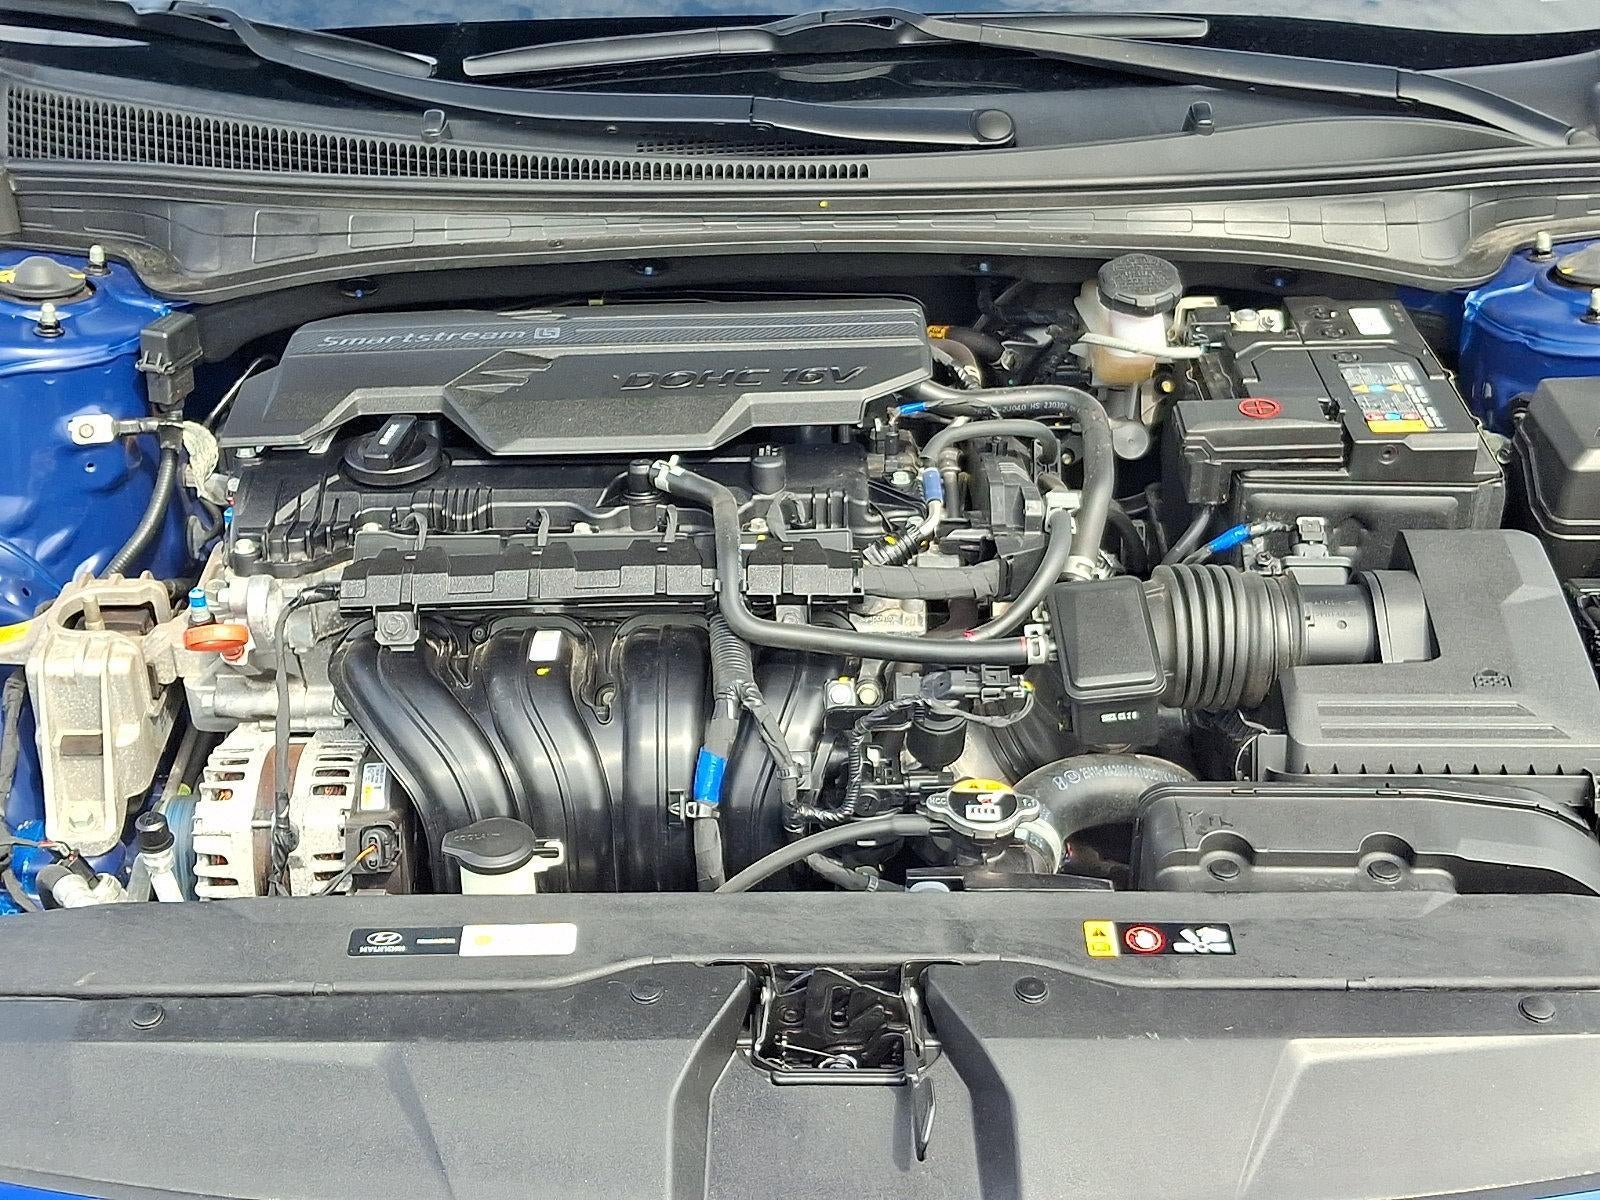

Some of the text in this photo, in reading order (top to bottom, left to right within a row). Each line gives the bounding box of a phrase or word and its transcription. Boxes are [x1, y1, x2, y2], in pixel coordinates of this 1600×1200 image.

[318, 328, 526, 347] Smartstream
[620, 365, 868, 391] DOHC 16V
